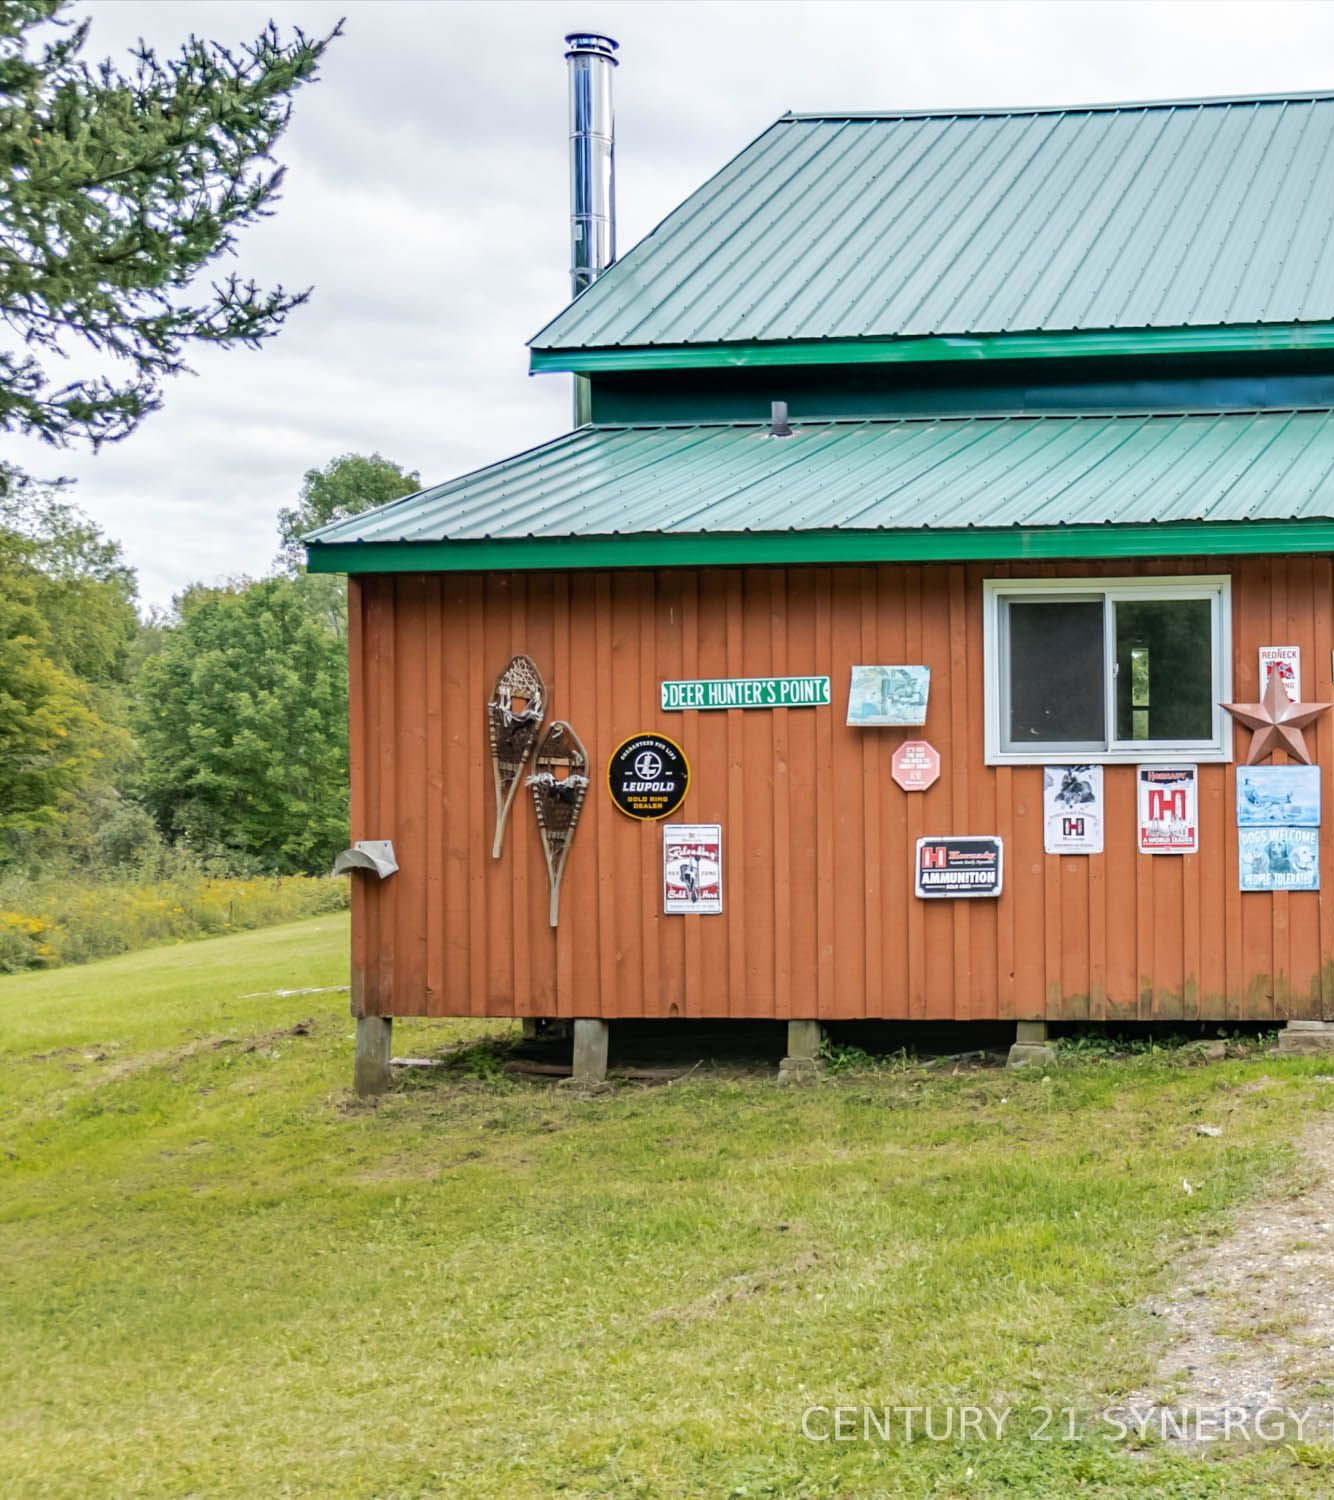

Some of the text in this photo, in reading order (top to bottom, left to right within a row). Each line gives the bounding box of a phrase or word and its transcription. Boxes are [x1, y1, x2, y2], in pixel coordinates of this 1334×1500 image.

[1262, 650, 1297, 659] REDNECK
[669, 680, 822, 706] DEER HUNTER'S POINT
[622, 782, 675, 792] LEUPOLD
[1242, 829, 1316, 844] DOGS WELCOME
[668, 845, 715, 860] Reloading
[921, 871, 996, 884] AMMUNITION
[1244, 871, 1313, 885] PEOPLE TOLERATED
[667, 889, 687, 899] Sold
